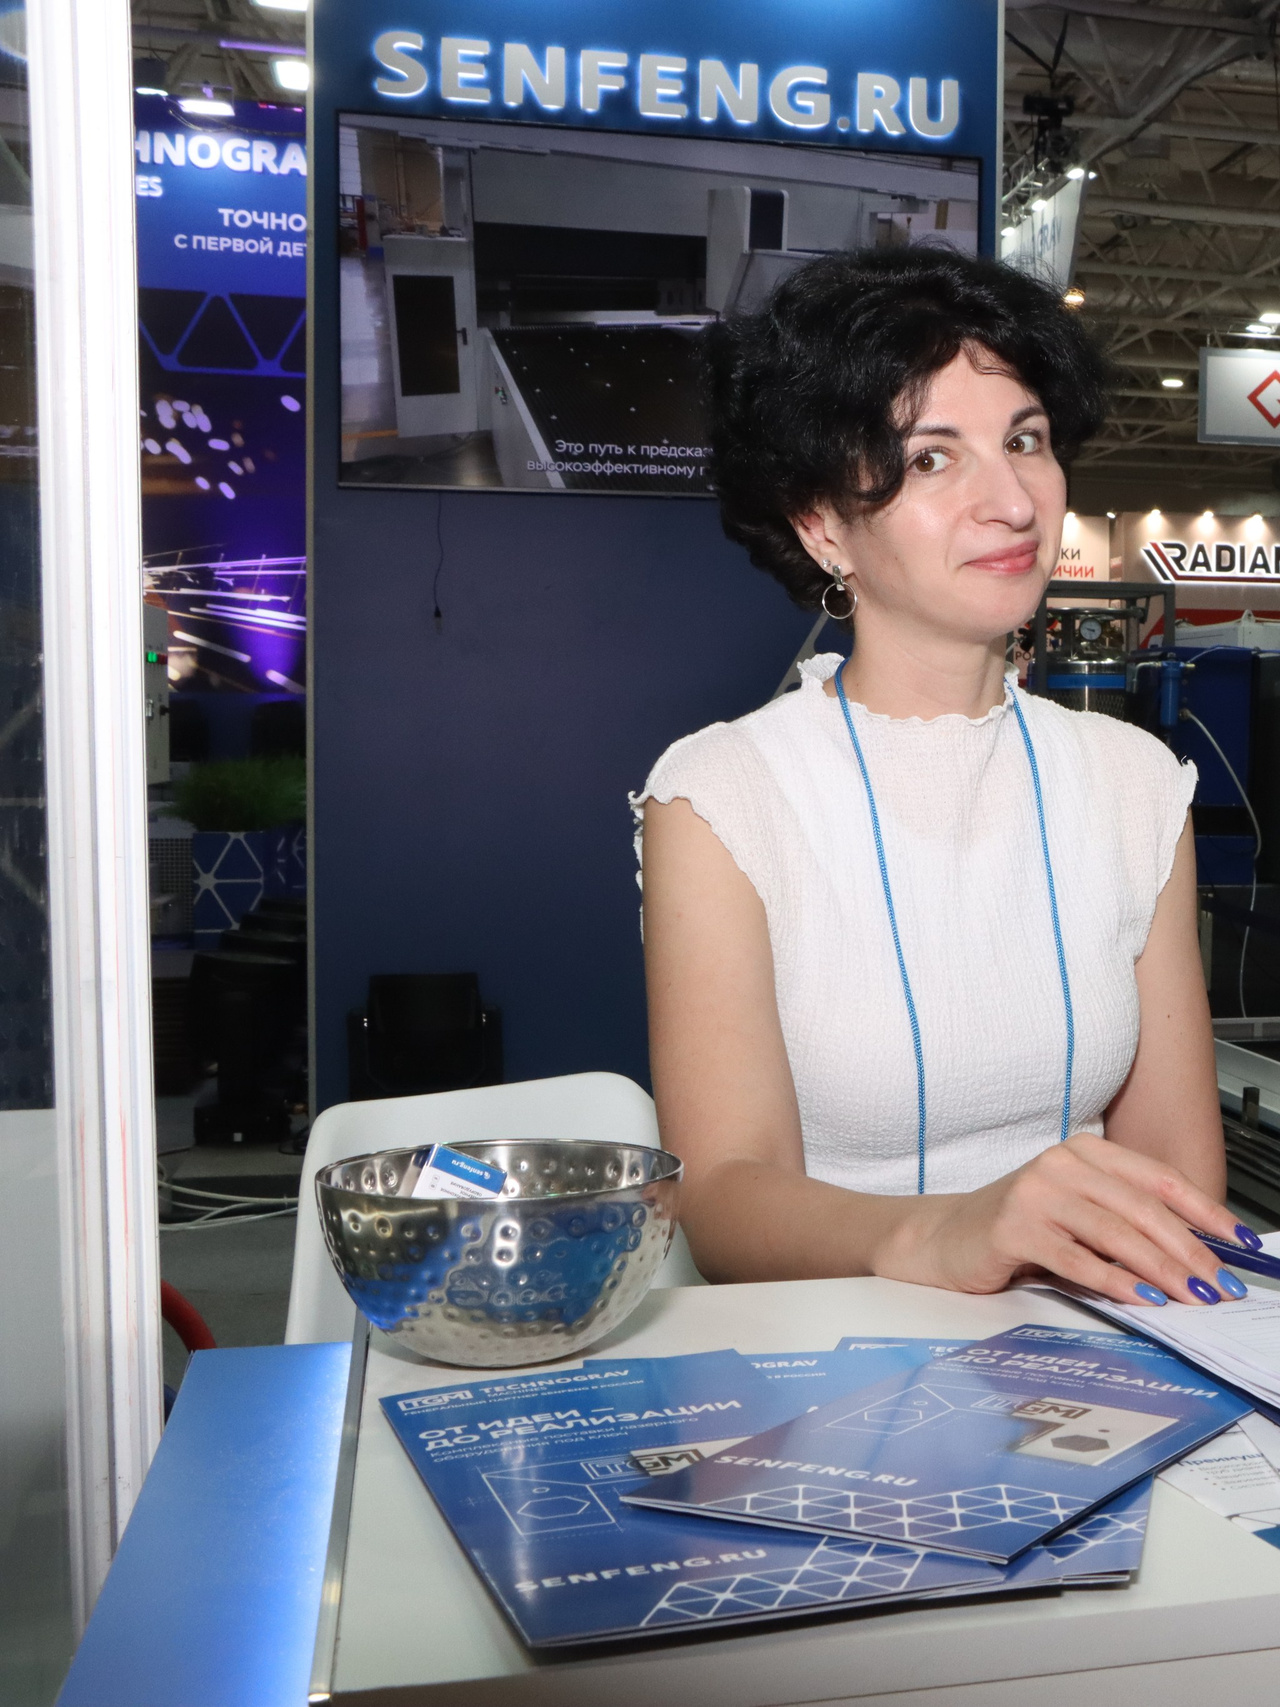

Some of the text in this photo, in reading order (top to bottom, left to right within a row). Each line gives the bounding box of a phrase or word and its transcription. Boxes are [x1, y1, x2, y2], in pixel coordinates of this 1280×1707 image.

[372, 30, 961, 139] SENFENG.RU
[135, 130, 307, 176] HNOGRA
[218, 208, 307, 232] ТОЧНО
[174, 234, 307, 258] С ПЕРВОЙ ДЕ
[555, 440, 584, 454] Это
[589, 444, 622, 457] путь
[628, 446, 636, 454] к
[527, 460, 695, 478] высокоэффективному
[452, 1160, 484, 1176] senfeng.ru
[967, 1348, 1010, 1358] ОТ
[1011, 1352, 1100, 1370] ИДЕИ
[479, 1370, 629, 1394] TECHNOGRAV
[946, 1354, 1219, 1400] ДО РЕАЛИЗАЦИИ
[404, 1399, 487, 1416] ГЕНЕРАЛЬНЫЙ
[489, 1392, 538, 1403] ПАРТНЕР
[599, 1380, 644, 1388] РОССИИ
[488, 1386, 548, 1398] MACHINES
[418, 1424, 468, 1440] ОТ
[478, 1410, 580, 1431] ИДЕИ
[426, 1400, 742, 1451] ДО РЕАЛИЗАЦИИ
[544, 1426, 615, 1440] поставки
[620, 1417, 698, 1431] лазерного
[554, 1436, 586, 1446] под
[588, 1430, 628, 1440] ключ
[715, 1455, 918, 1488] SENFENG.RU
[514, 1548, 767, 1593] SENFENG.RU
